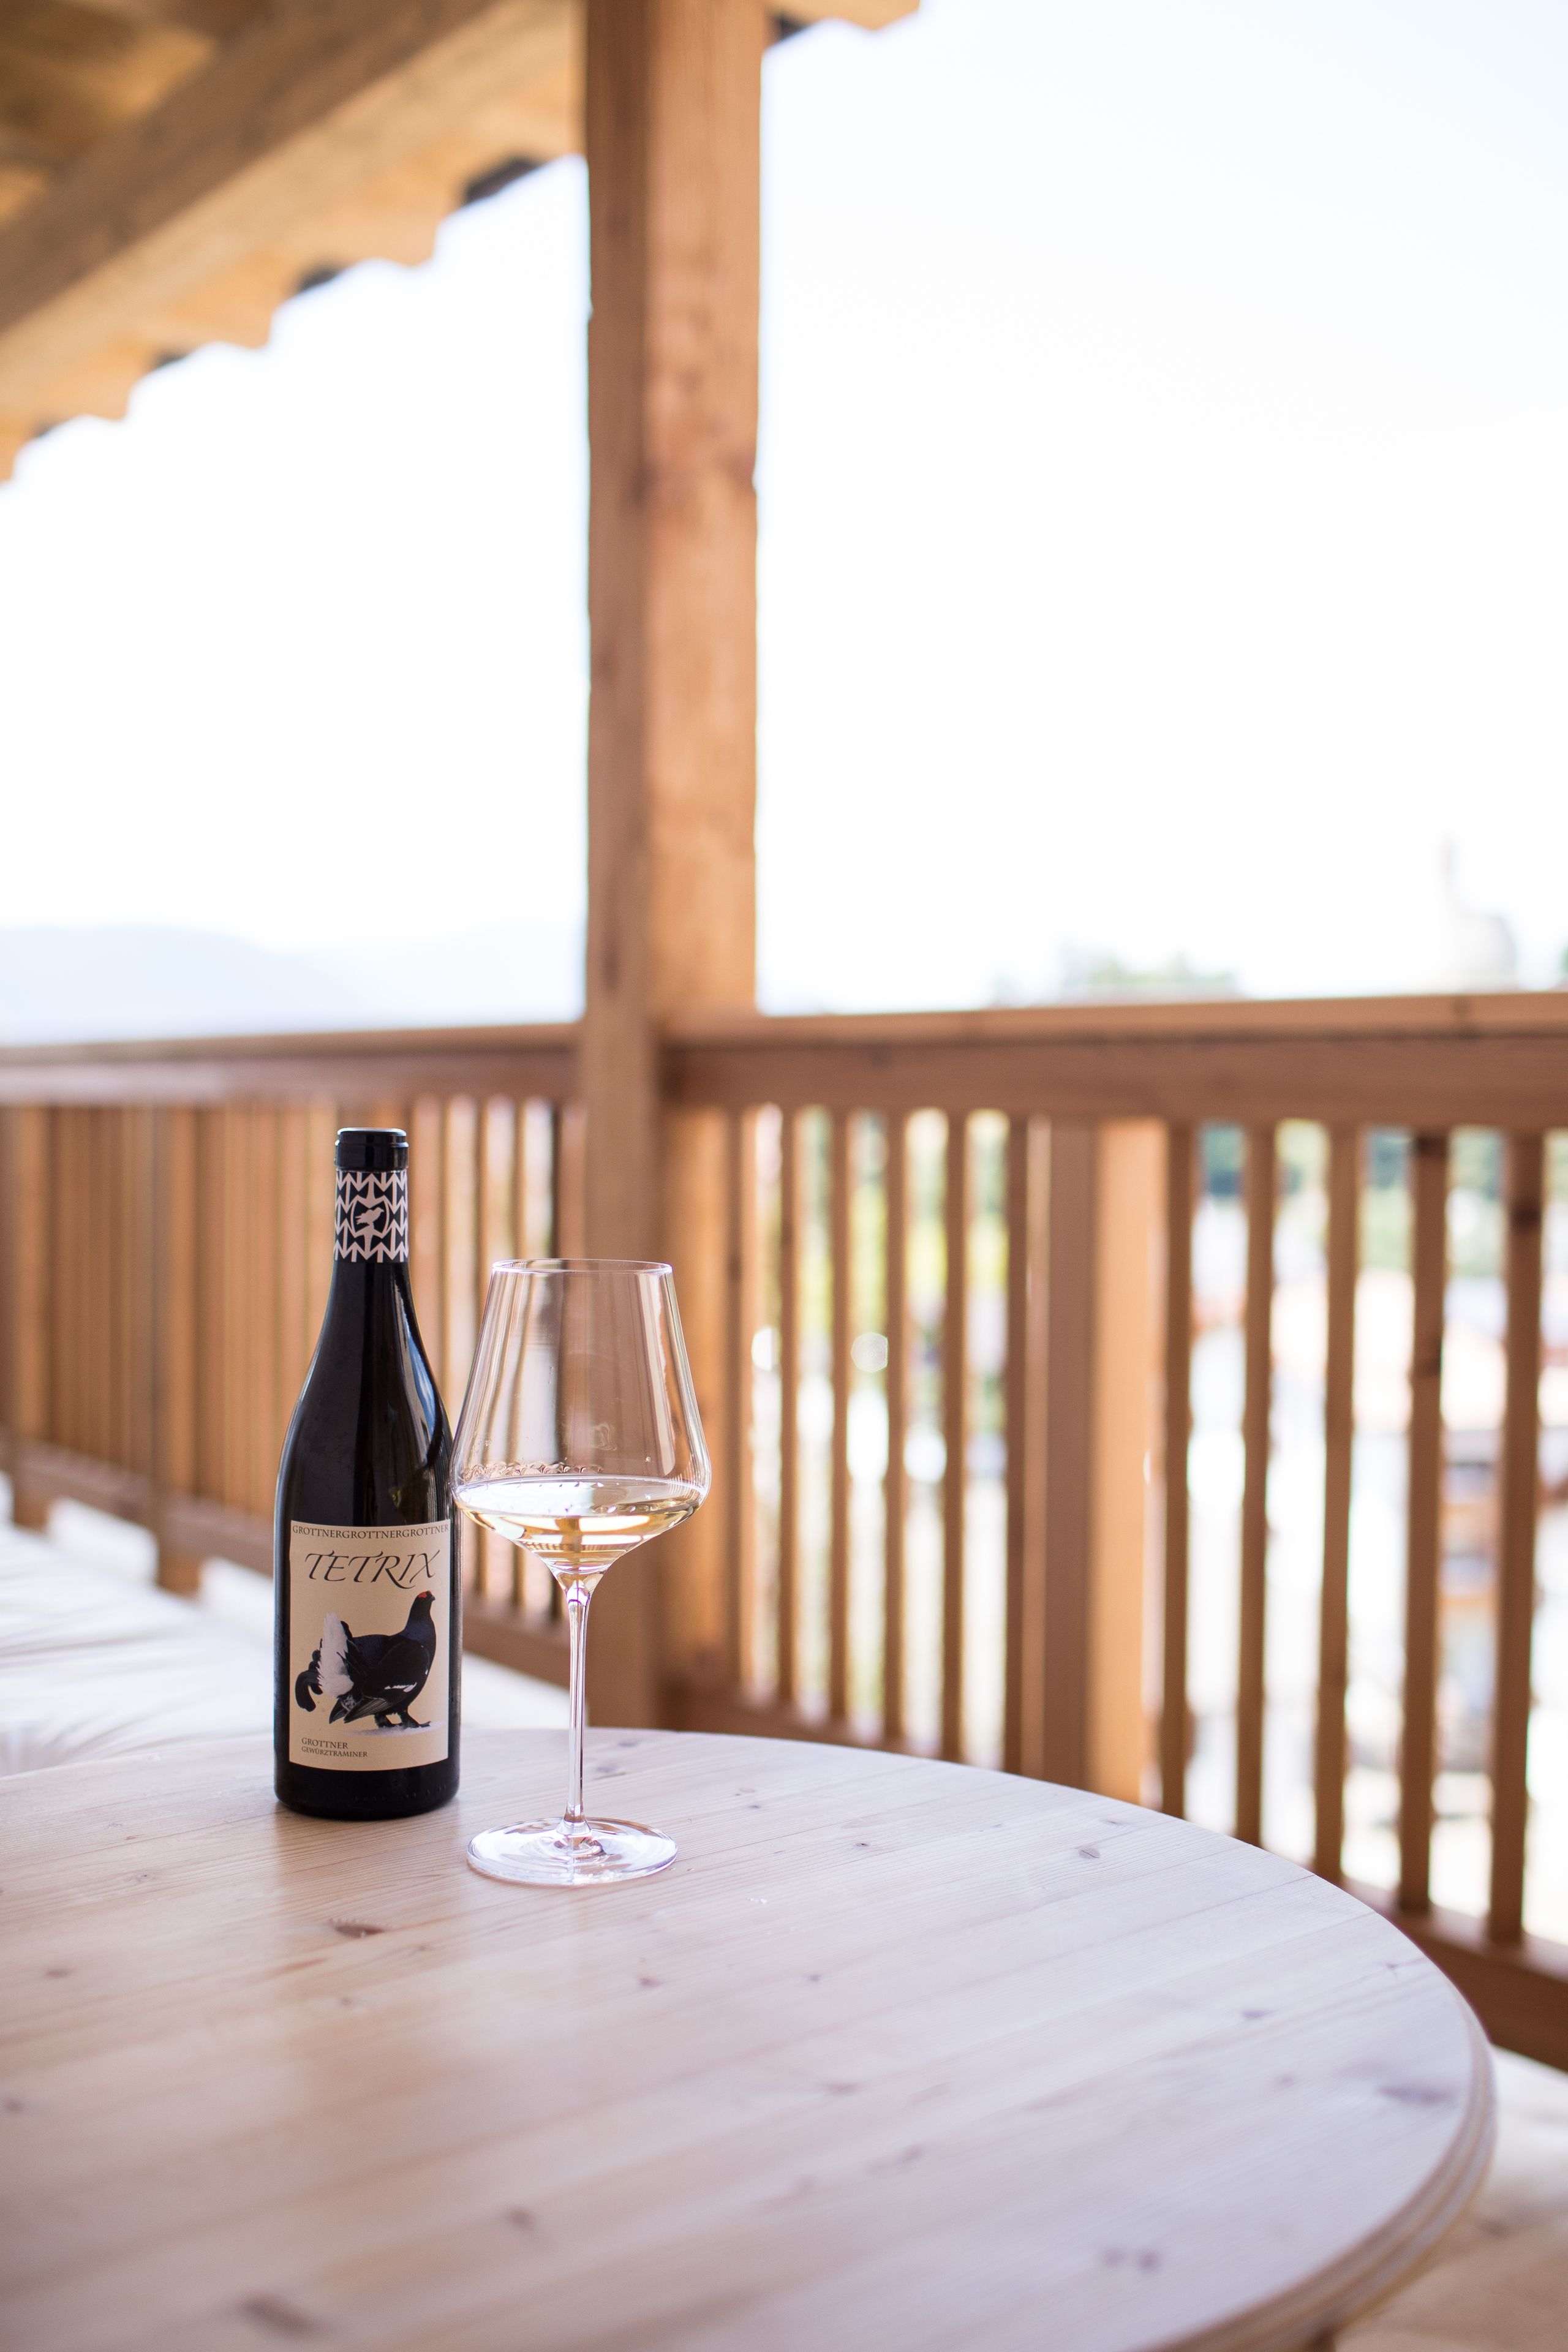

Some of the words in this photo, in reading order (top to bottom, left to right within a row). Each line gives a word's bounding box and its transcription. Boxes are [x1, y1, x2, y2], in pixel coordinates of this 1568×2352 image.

[304, 1549, 440, 1589] TETRIX
[301, 1737, 349, 1749] GROTTNER
[301, 1746, 368, 1758] GEWÜRZTRAMINER
